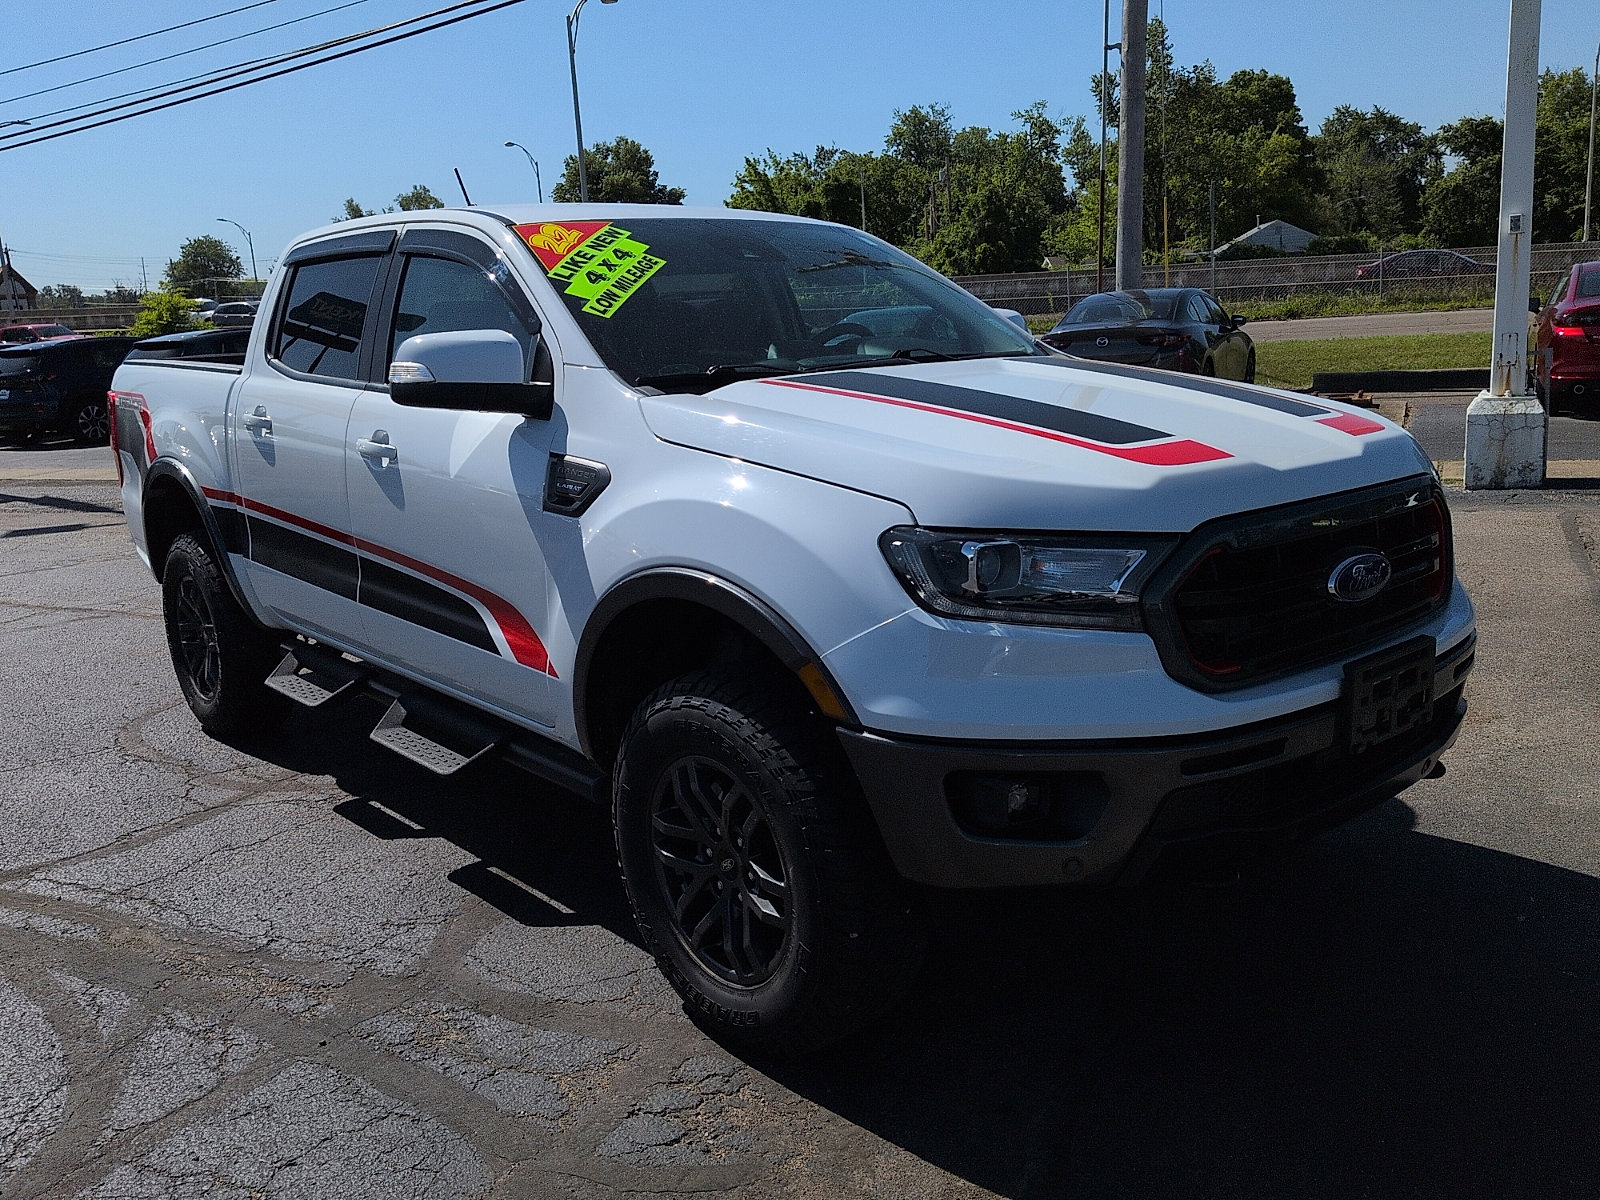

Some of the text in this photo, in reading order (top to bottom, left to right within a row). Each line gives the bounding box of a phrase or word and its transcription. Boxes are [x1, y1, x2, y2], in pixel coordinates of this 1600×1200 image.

[529, 223, 584, 255] 22
[553, 226, 624, 281] LIKE NEW
[585, 270, 611, 285] 4
[611, 247, 636, 261] 4
[588, 255, 660, 316] LOW MILEAGE
